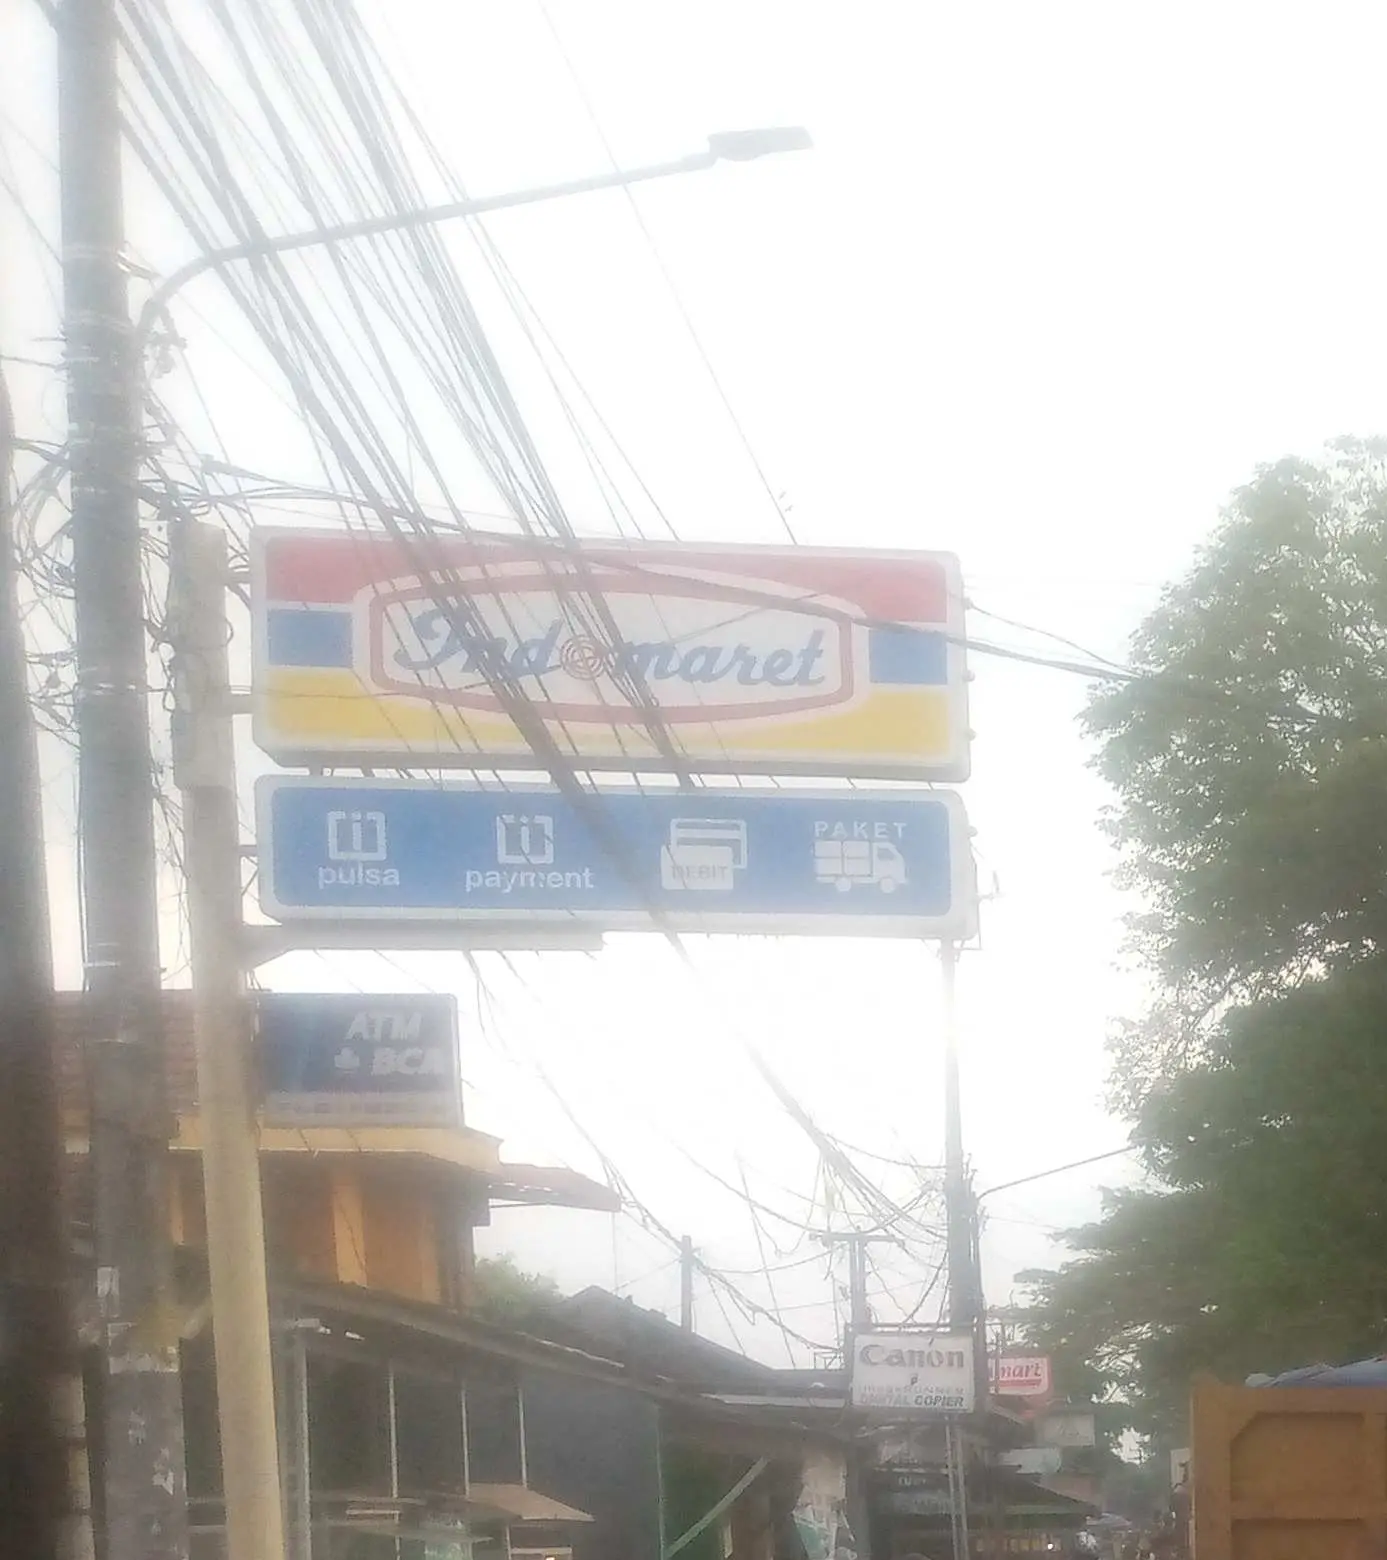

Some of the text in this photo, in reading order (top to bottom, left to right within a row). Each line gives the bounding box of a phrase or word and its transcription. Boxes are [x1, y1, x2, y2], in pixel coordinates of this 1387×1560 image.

[813, 820, 908, 839] PAKET
[317, 860, 400, 890] pulsa
[464, 866, 595, 893] payment
[670, 864, 728, 880] DEBIT
[345, 1011, 423, 1041] ATM
[371, 1047, 446, 1076] BCA
[859, 1344, 965, 1369] Canon
[914, 1394, 964, 1407] COPIER
